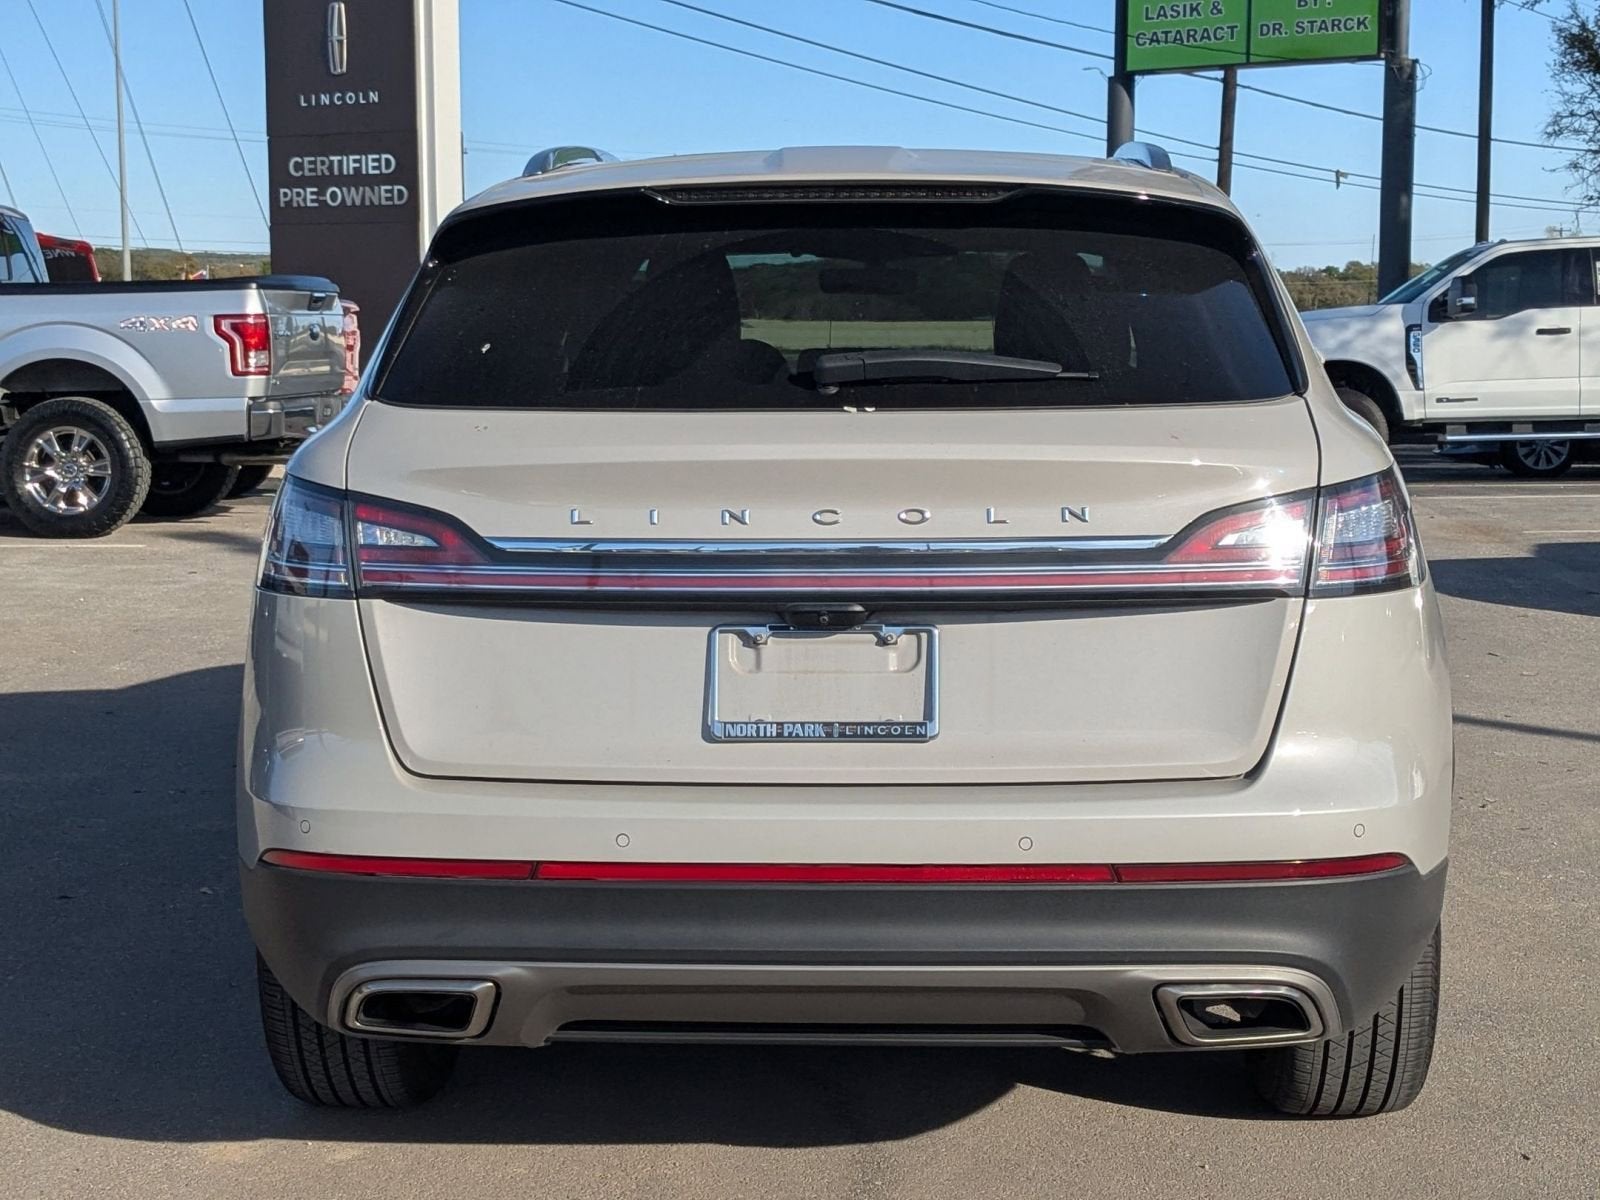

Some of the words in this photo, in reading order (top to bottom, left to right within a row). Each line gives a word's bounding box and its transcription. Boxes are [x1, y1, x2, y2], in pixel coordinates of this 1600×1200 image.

[1144, 2, 1203, 21] LASIK
[1210, 0, 1224, 16] &
[1135, 25, 1239, 47] CATARACT
[1259, 22, 1289, 37] DR.
[1295, 16, 1370, 35] STARCK
[300, 91, 379, 106] LINCOLN
[288, 153, 396, 177] CERTIFIED
[279, 185, 409, 207] PRE-OWNED
[570, 505, 1091, 526] LINCOLN
[725, 723, 777, 737] NORTH
[783, 723, 826, 737] PARK
[845, 724, 926, 736] LINCOLN
